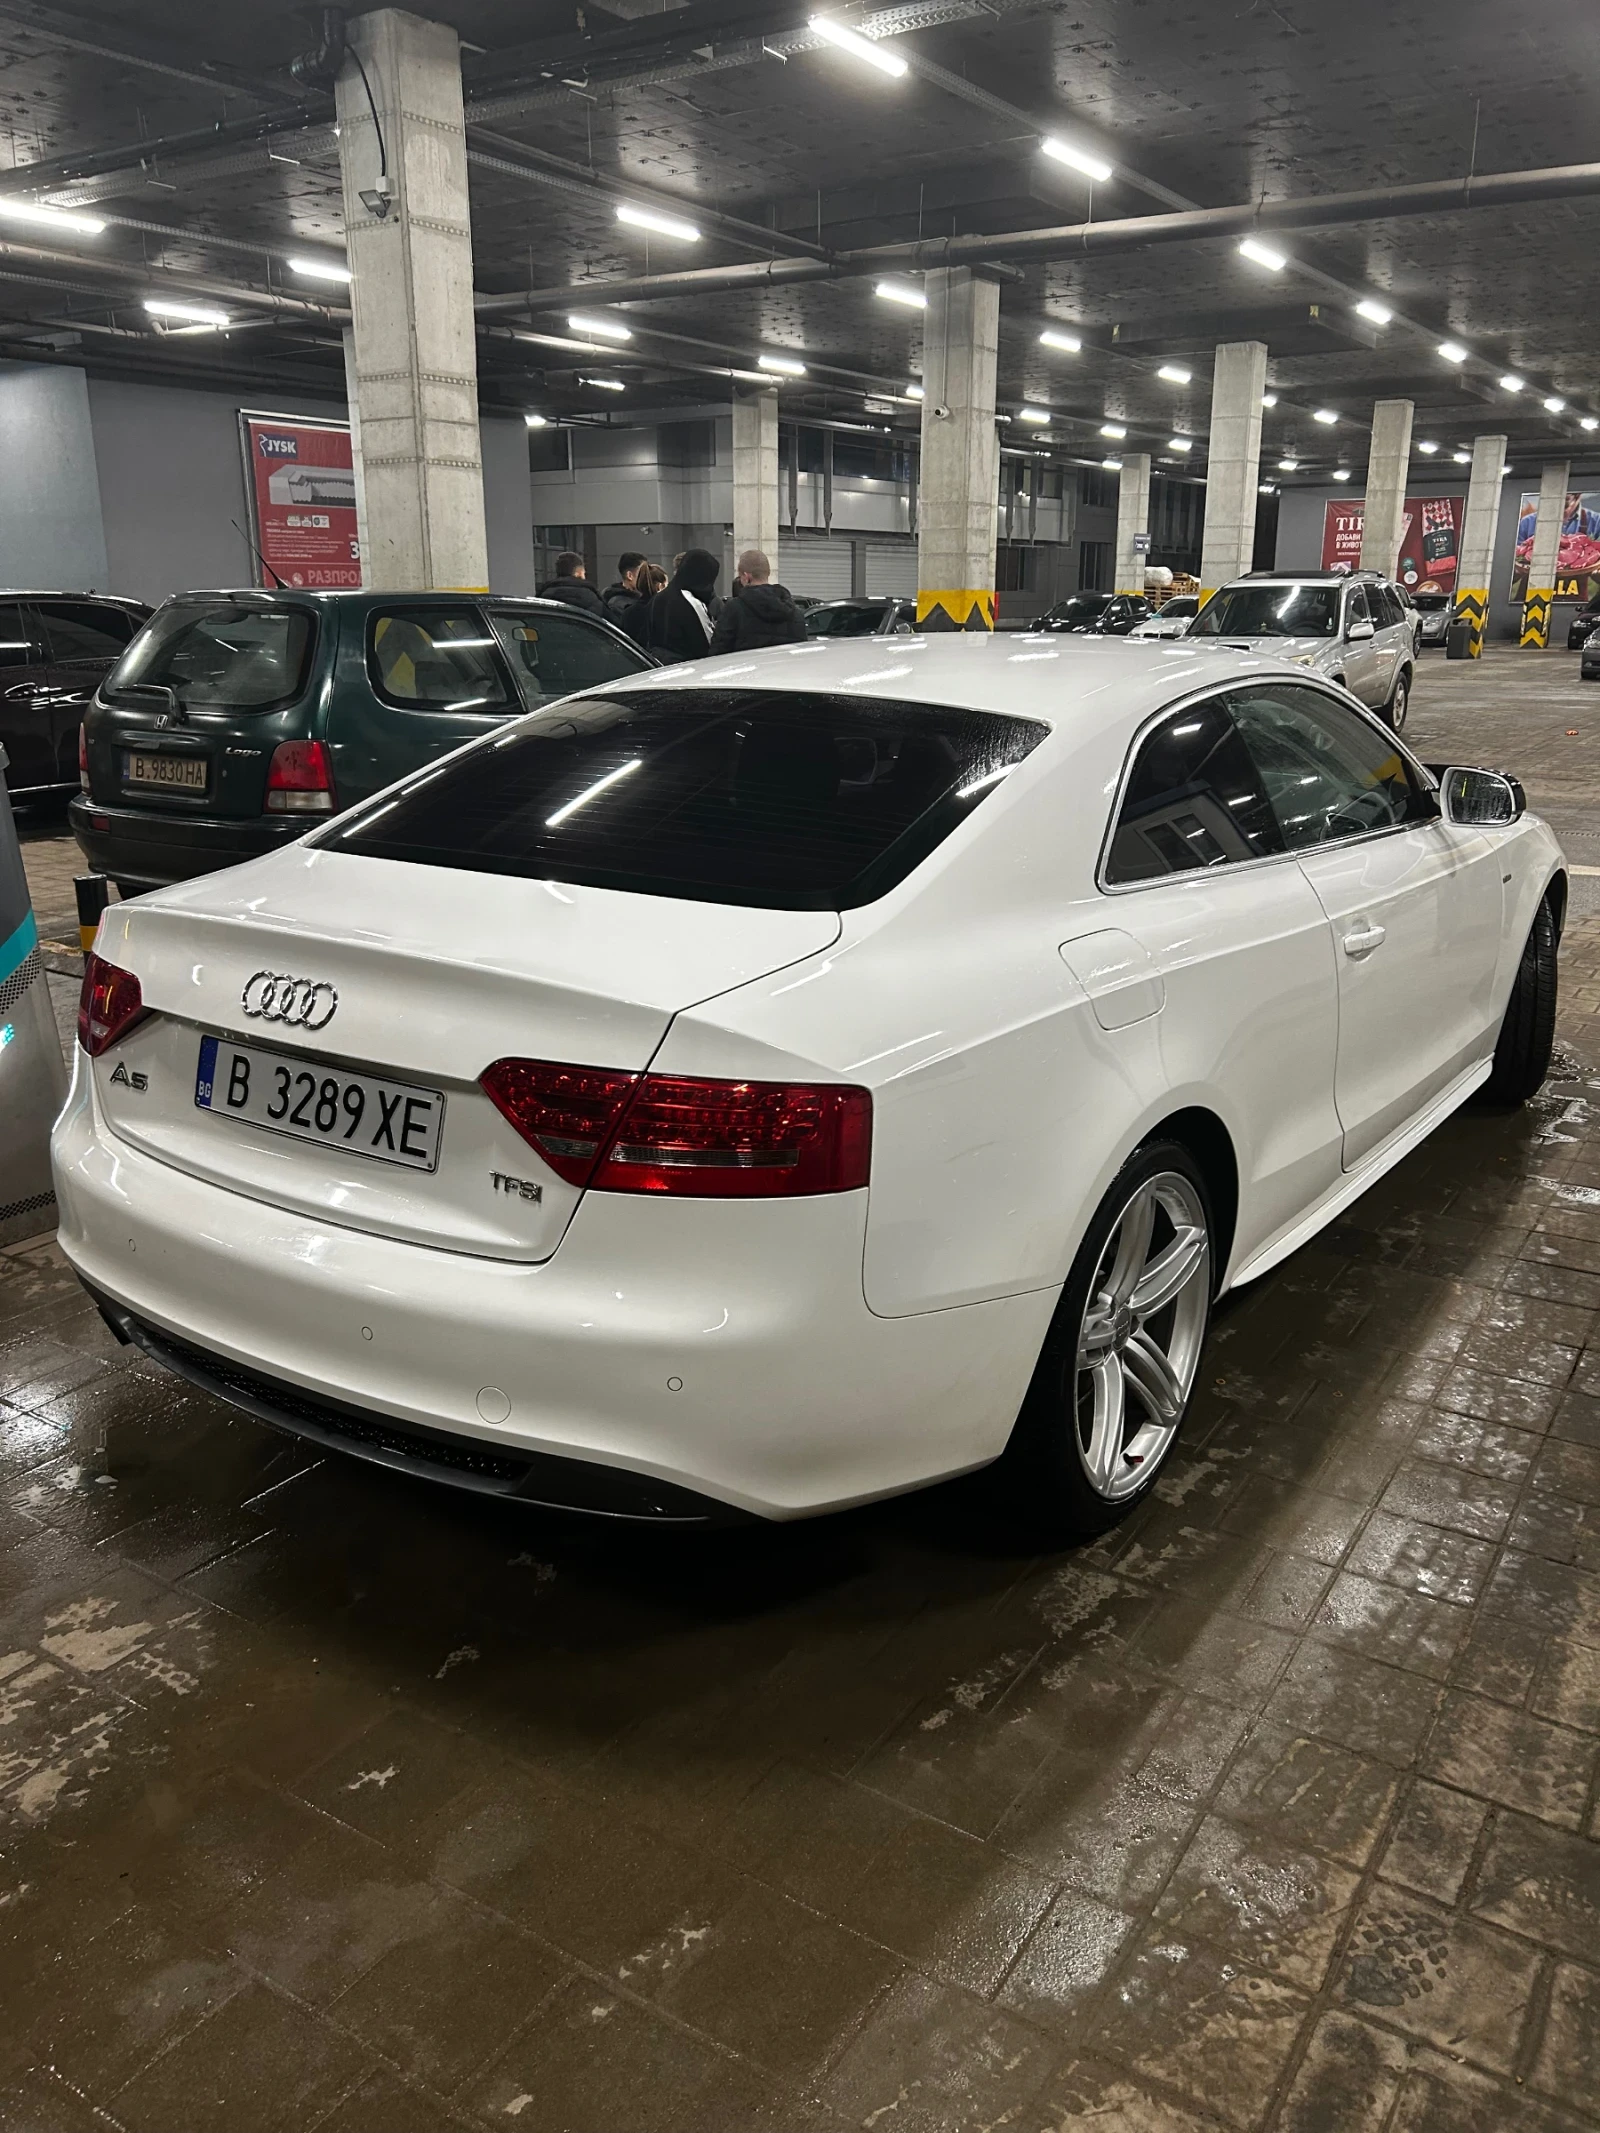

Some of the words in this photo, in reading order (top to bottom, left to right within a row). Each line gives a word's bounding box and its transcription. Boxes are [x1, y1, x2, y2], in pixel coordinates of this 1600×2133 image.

[268, 440, 296, 453] JYSK
[225, 746, 262, 757] Logo
[110, 1061, 149, 1091] A5
[198, 1080, 212, 1098] BG
[227, 1054, 250, 1108] B
[267, 1066, 366, 1139] 3289
[371, 1090, 432, 1159] XE
[488, 1170, 543, 1204] TFSI
